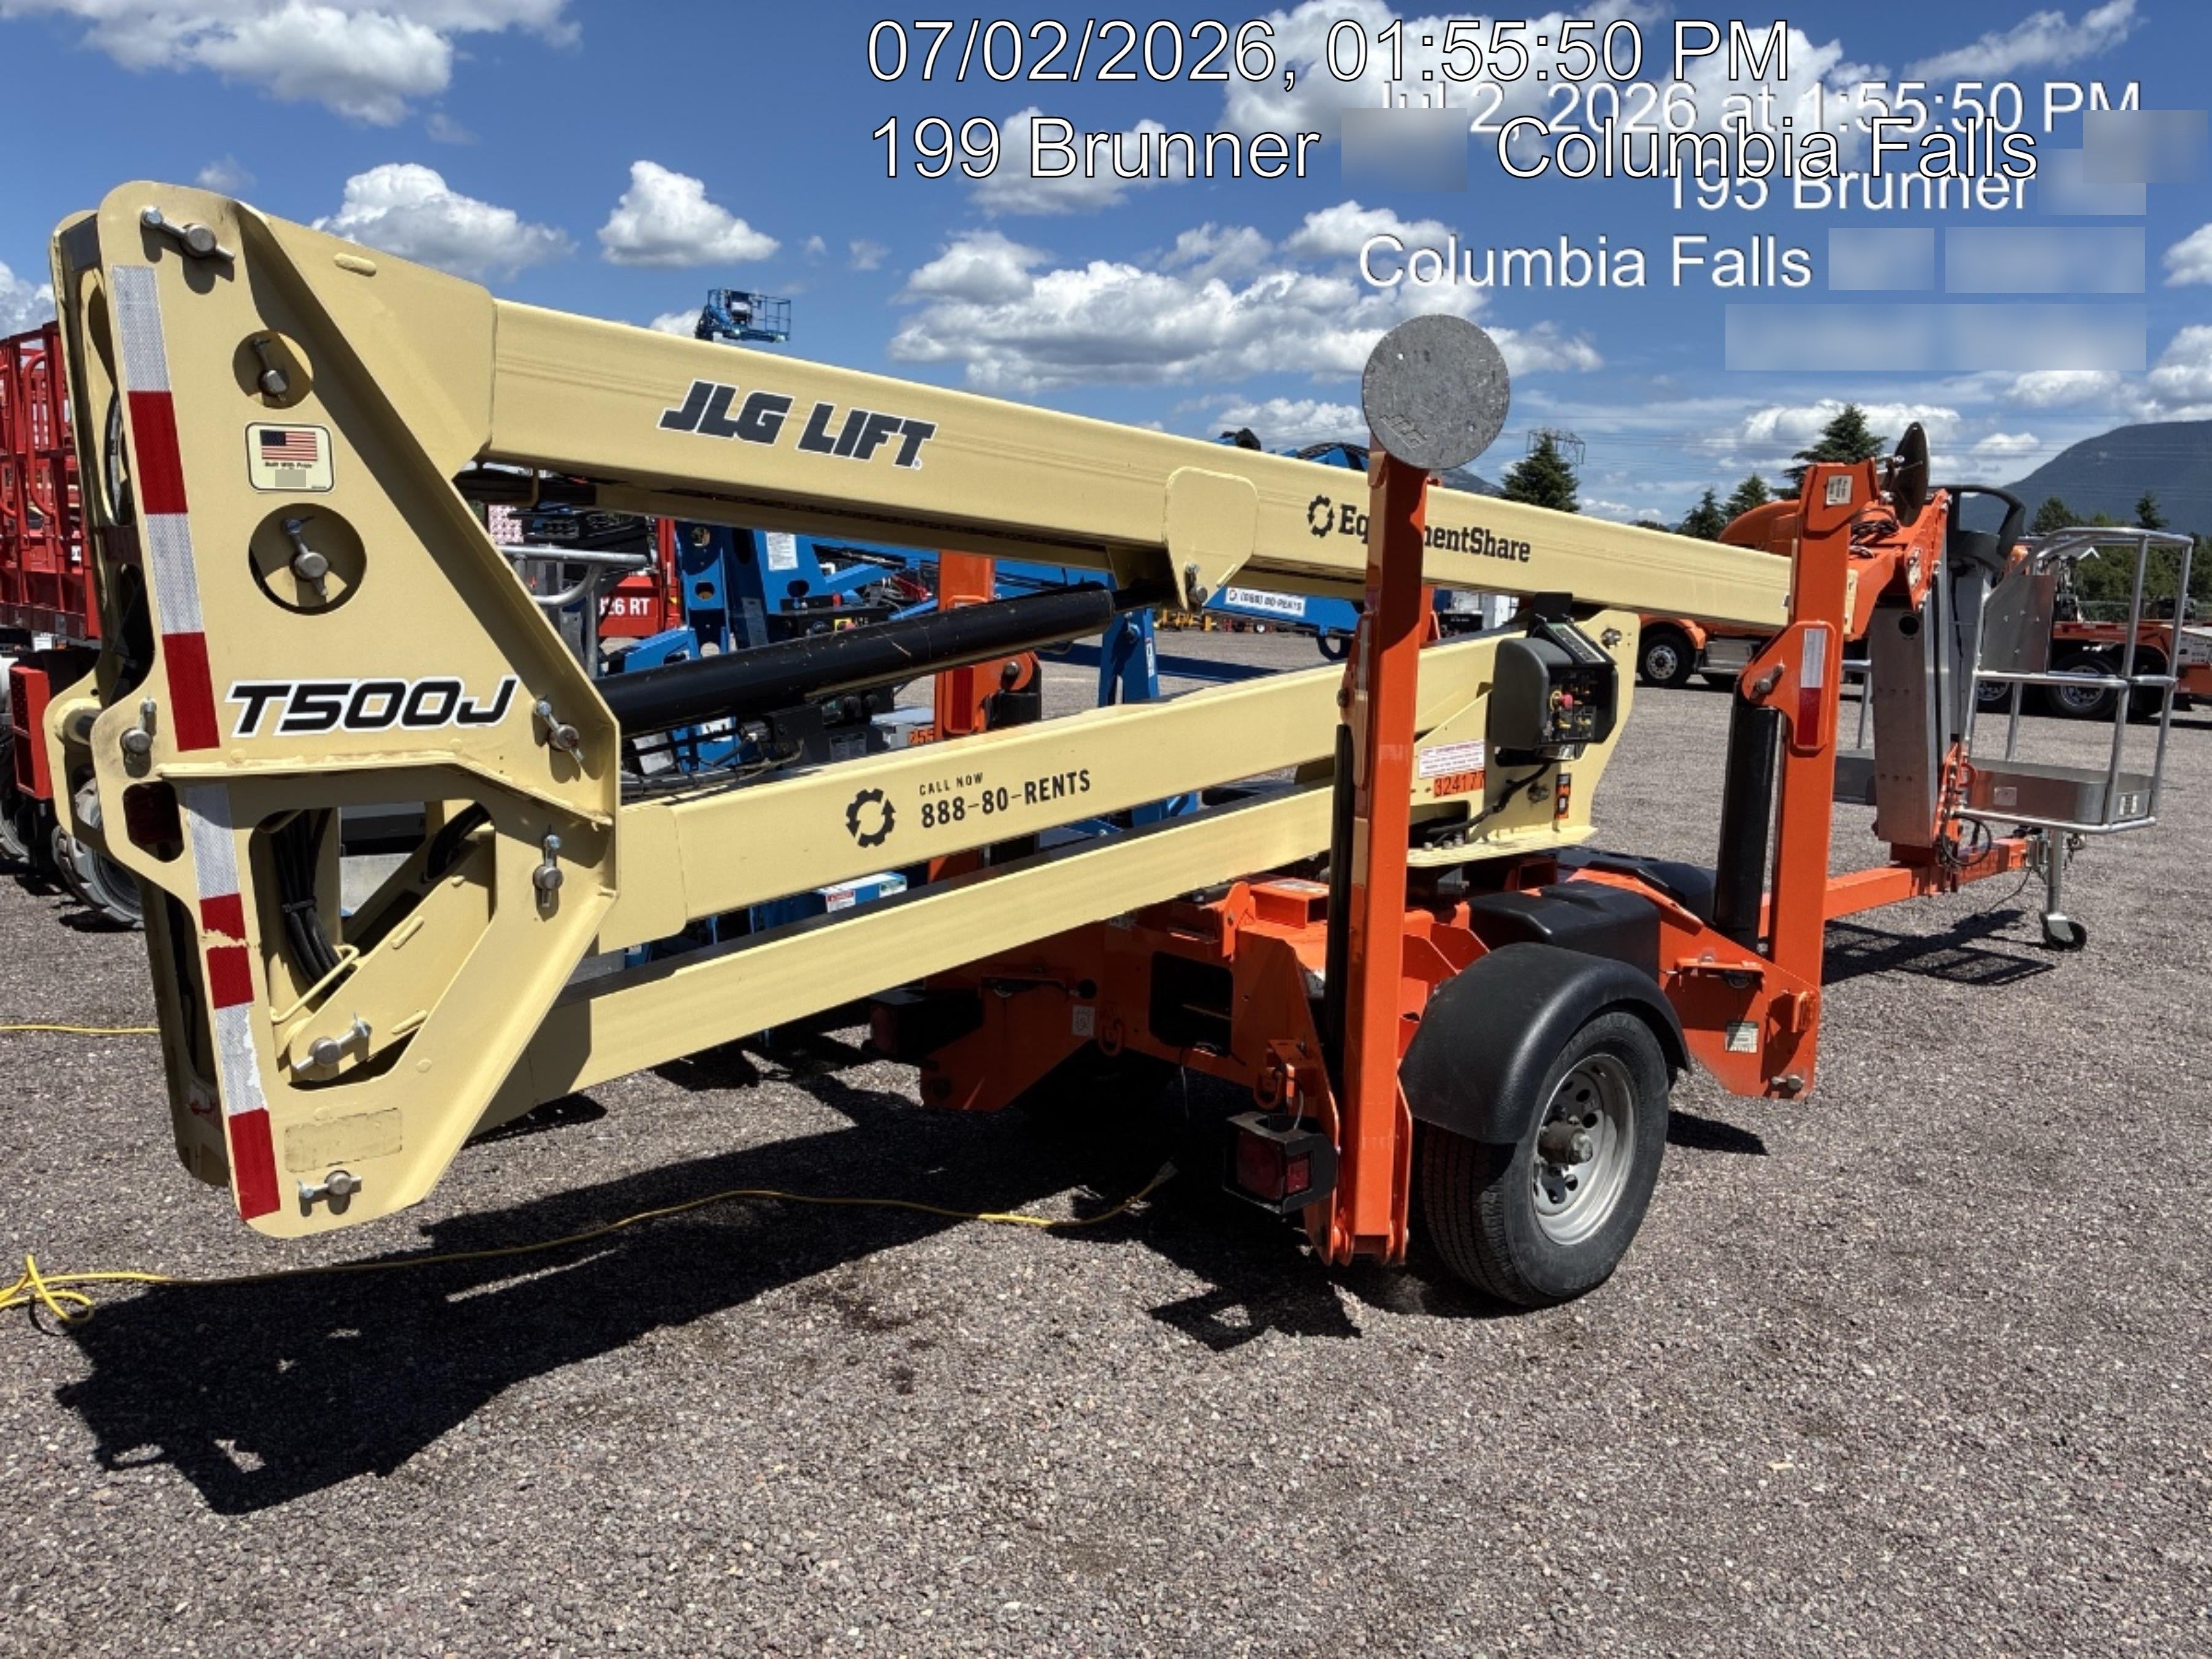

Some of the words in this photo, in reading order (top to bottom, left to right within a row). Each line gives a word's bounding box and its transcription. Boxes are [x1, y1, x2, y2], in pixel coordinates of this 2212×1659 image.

[657, 379, 794, 445] JLG
[797, 401, 938, 468] LIFT
[1338, 503, 1532, 563] EqentShare
[629, 597, 651, 616] RT
[230, 677, 519, 736] T500J
[919, 779, 951, 797] CALL
[956, 772, 984, 788] NOW
[921, 769, 1091, 828] 888-80-RENTS
